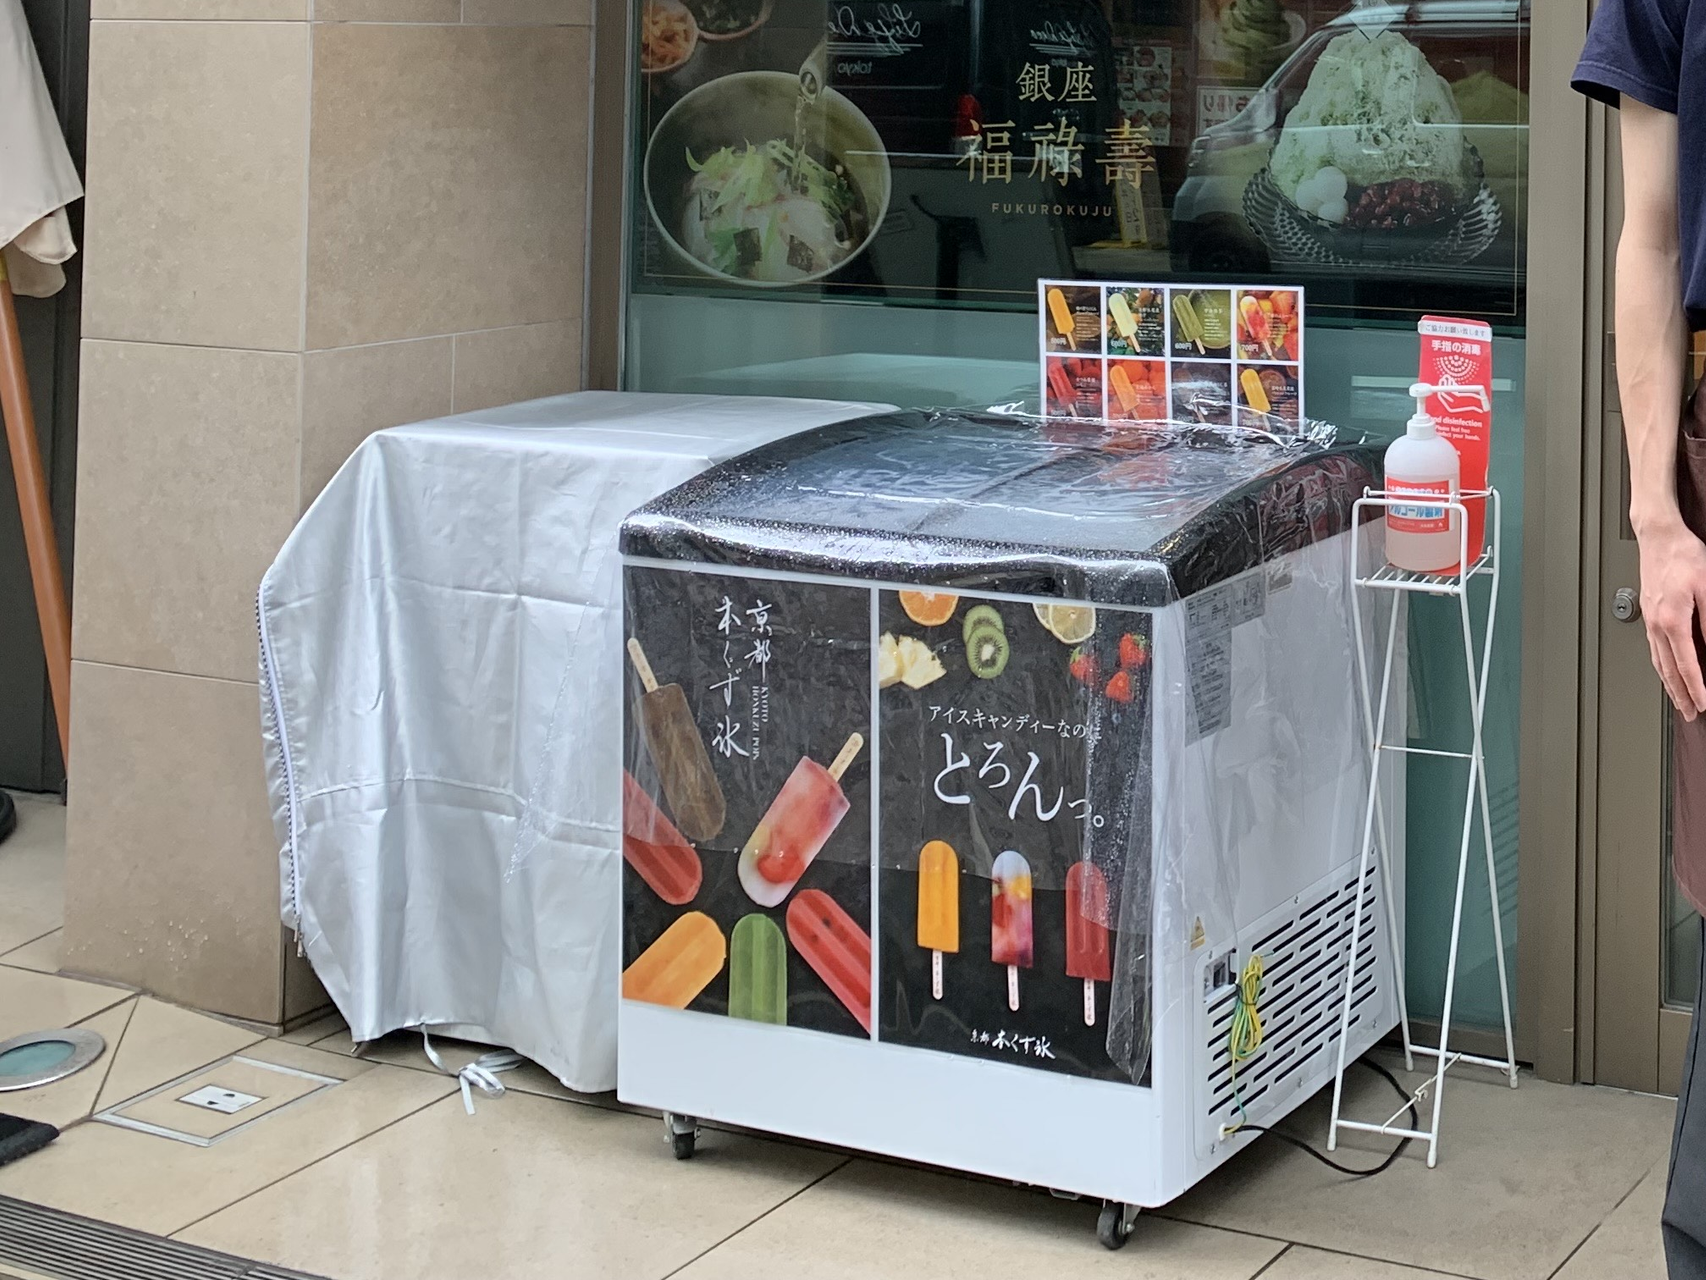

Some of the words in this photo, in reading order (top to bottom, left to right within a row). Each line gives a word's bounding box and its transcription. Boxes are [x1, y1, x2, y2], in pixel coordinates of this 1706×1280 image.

[1015, 61, 1098, 104] 銀座
[991, 202, 1114, 218] FUKUROKUJU
[1431, 339, 1482, 356] 手指の消毒
[1443, 416, 1483, 429] disinfection
[744, 598, 773, 684] 京都
[761, 685, 770, 723] KYOTO
